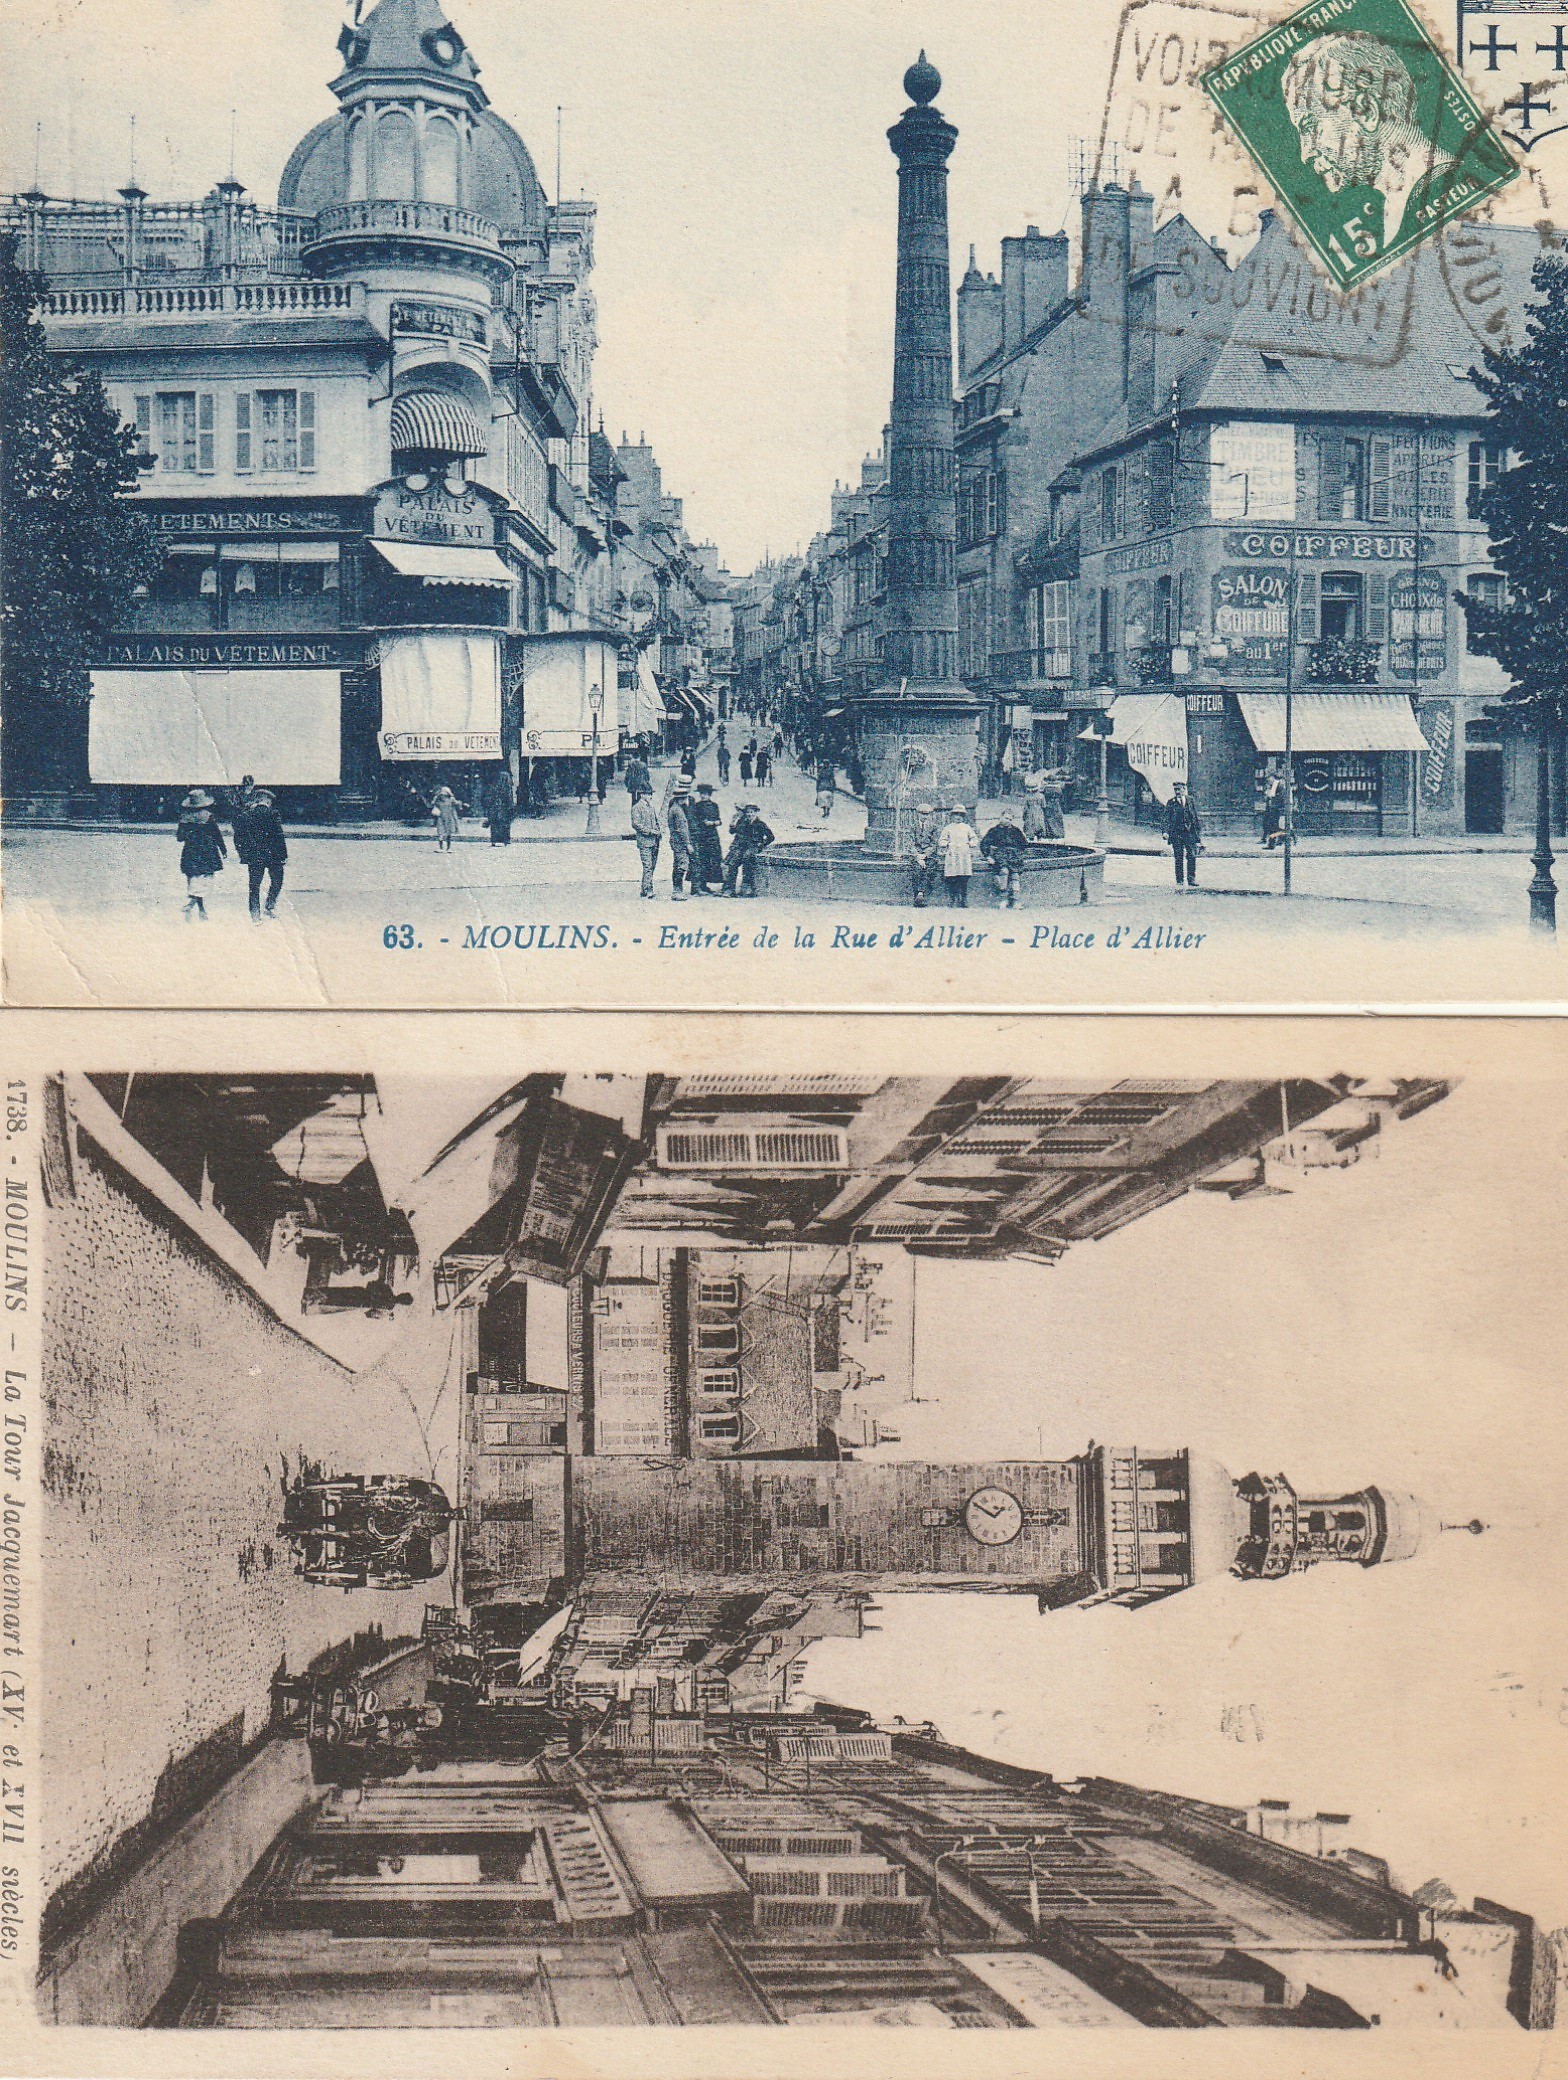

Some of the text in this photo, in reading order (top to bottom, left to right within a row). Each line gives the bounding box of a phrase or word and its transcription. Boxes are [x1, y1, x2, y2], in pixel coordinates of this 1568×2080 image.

[399, 494, 474, 515] PALAIS
[425, 512, 445, 522] DU
[1242, 534, 1417, 558] COIFFEUR
[1217, 574, 1289, 600] SALON
[1243, 598, 1260, 607] DE
[107, 644, 184, 662] PALAIS
[190, 648, 210, 662] DU
[1186, 694, 1225, 711] COIFFEUR
[407, 736, 442, 750] PALAIS
[1424, 711, 1453, 794] COIFFEUR
[1128, 743, 1185, 769] COIFFEUR
[570, 1351, 585, 1392] VERNIS
